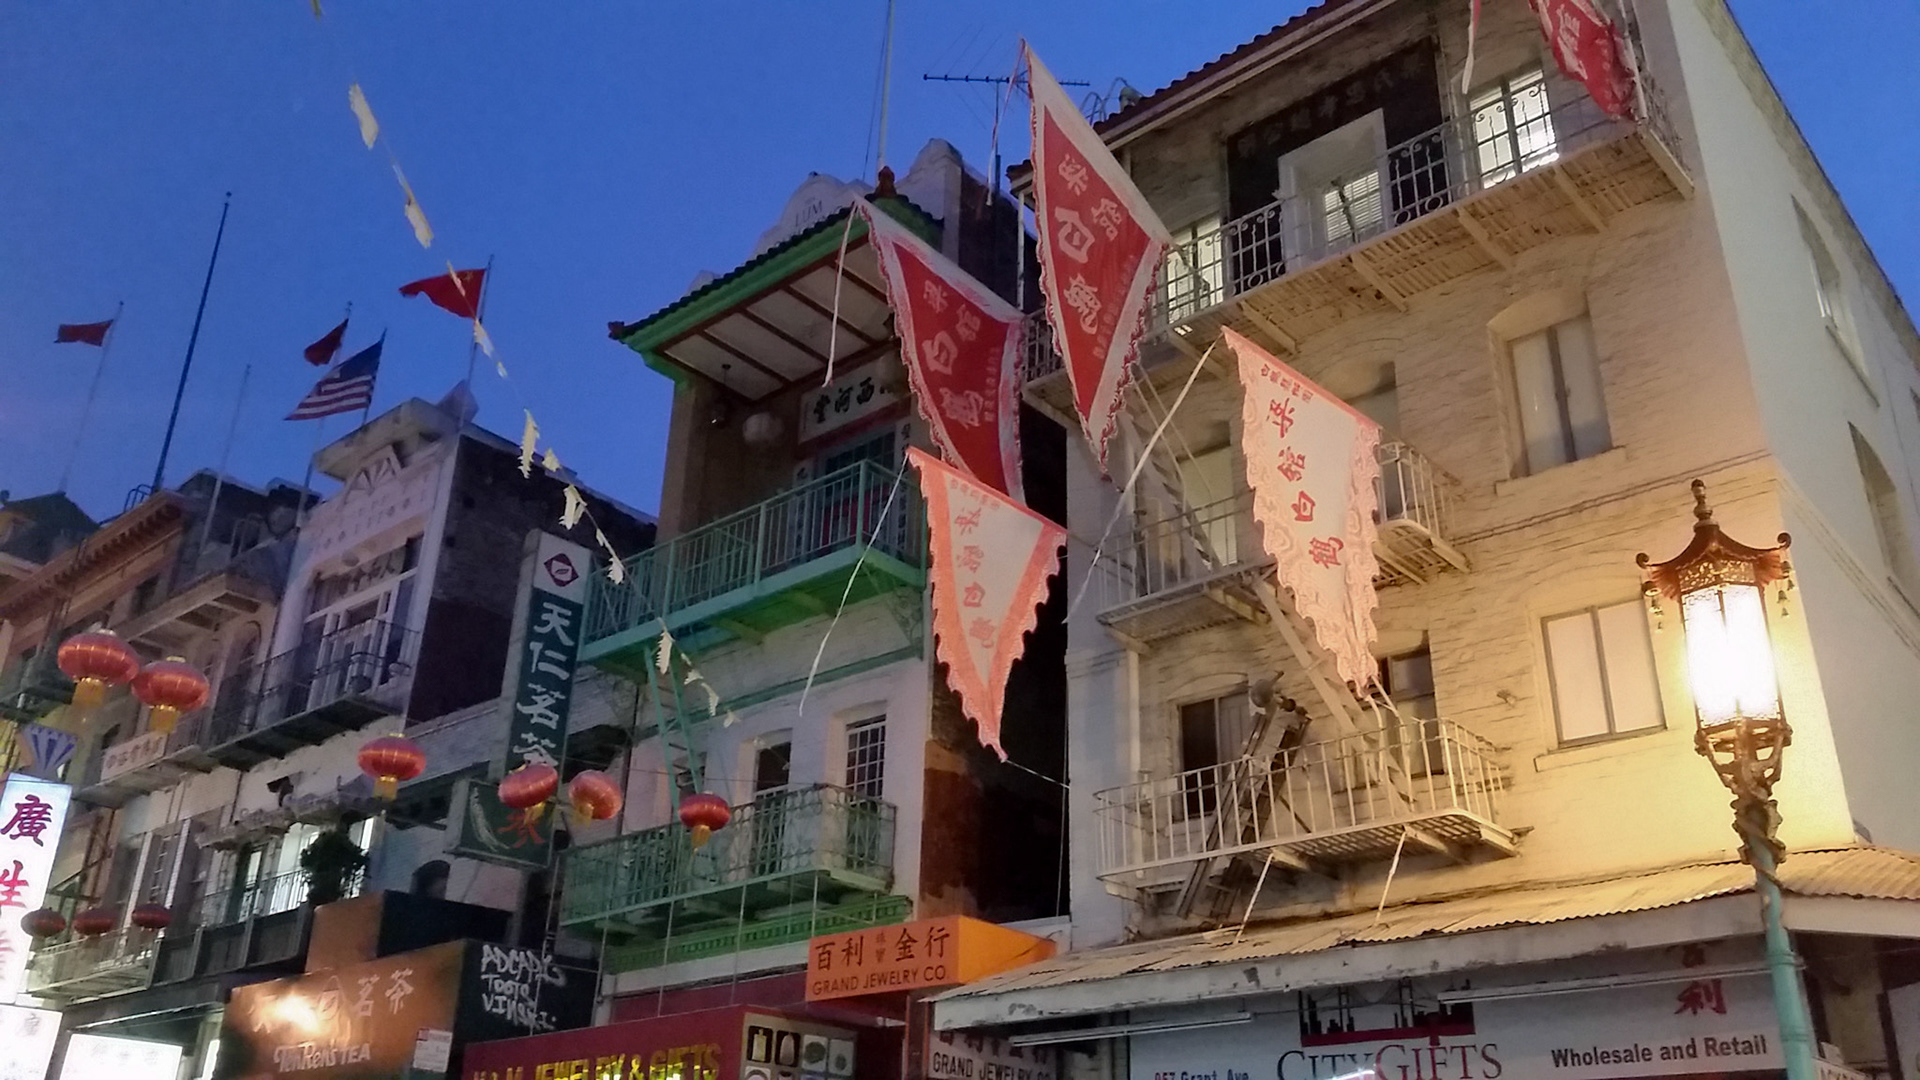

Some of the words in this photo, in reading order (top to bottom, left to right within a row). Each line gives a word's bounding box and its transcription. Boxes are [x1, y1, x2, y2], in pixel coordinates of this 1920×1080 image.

[513, 602, 575, 767] 天仁茗茶
[813, 976, 859, 996] GRAND
[863, 968, 918, 989] JEWELRY
[340, 1042, 371, 1065] TEA
[649, 1043, 721, 1080] GIFTS
[932, 1051, 974, 1078] GRAND
[1552, 1043, 1653, 1068] Wholesale
[1660, 1038, 1698, 1060] and
[1704, 1034, 1767, 1056] Retail
